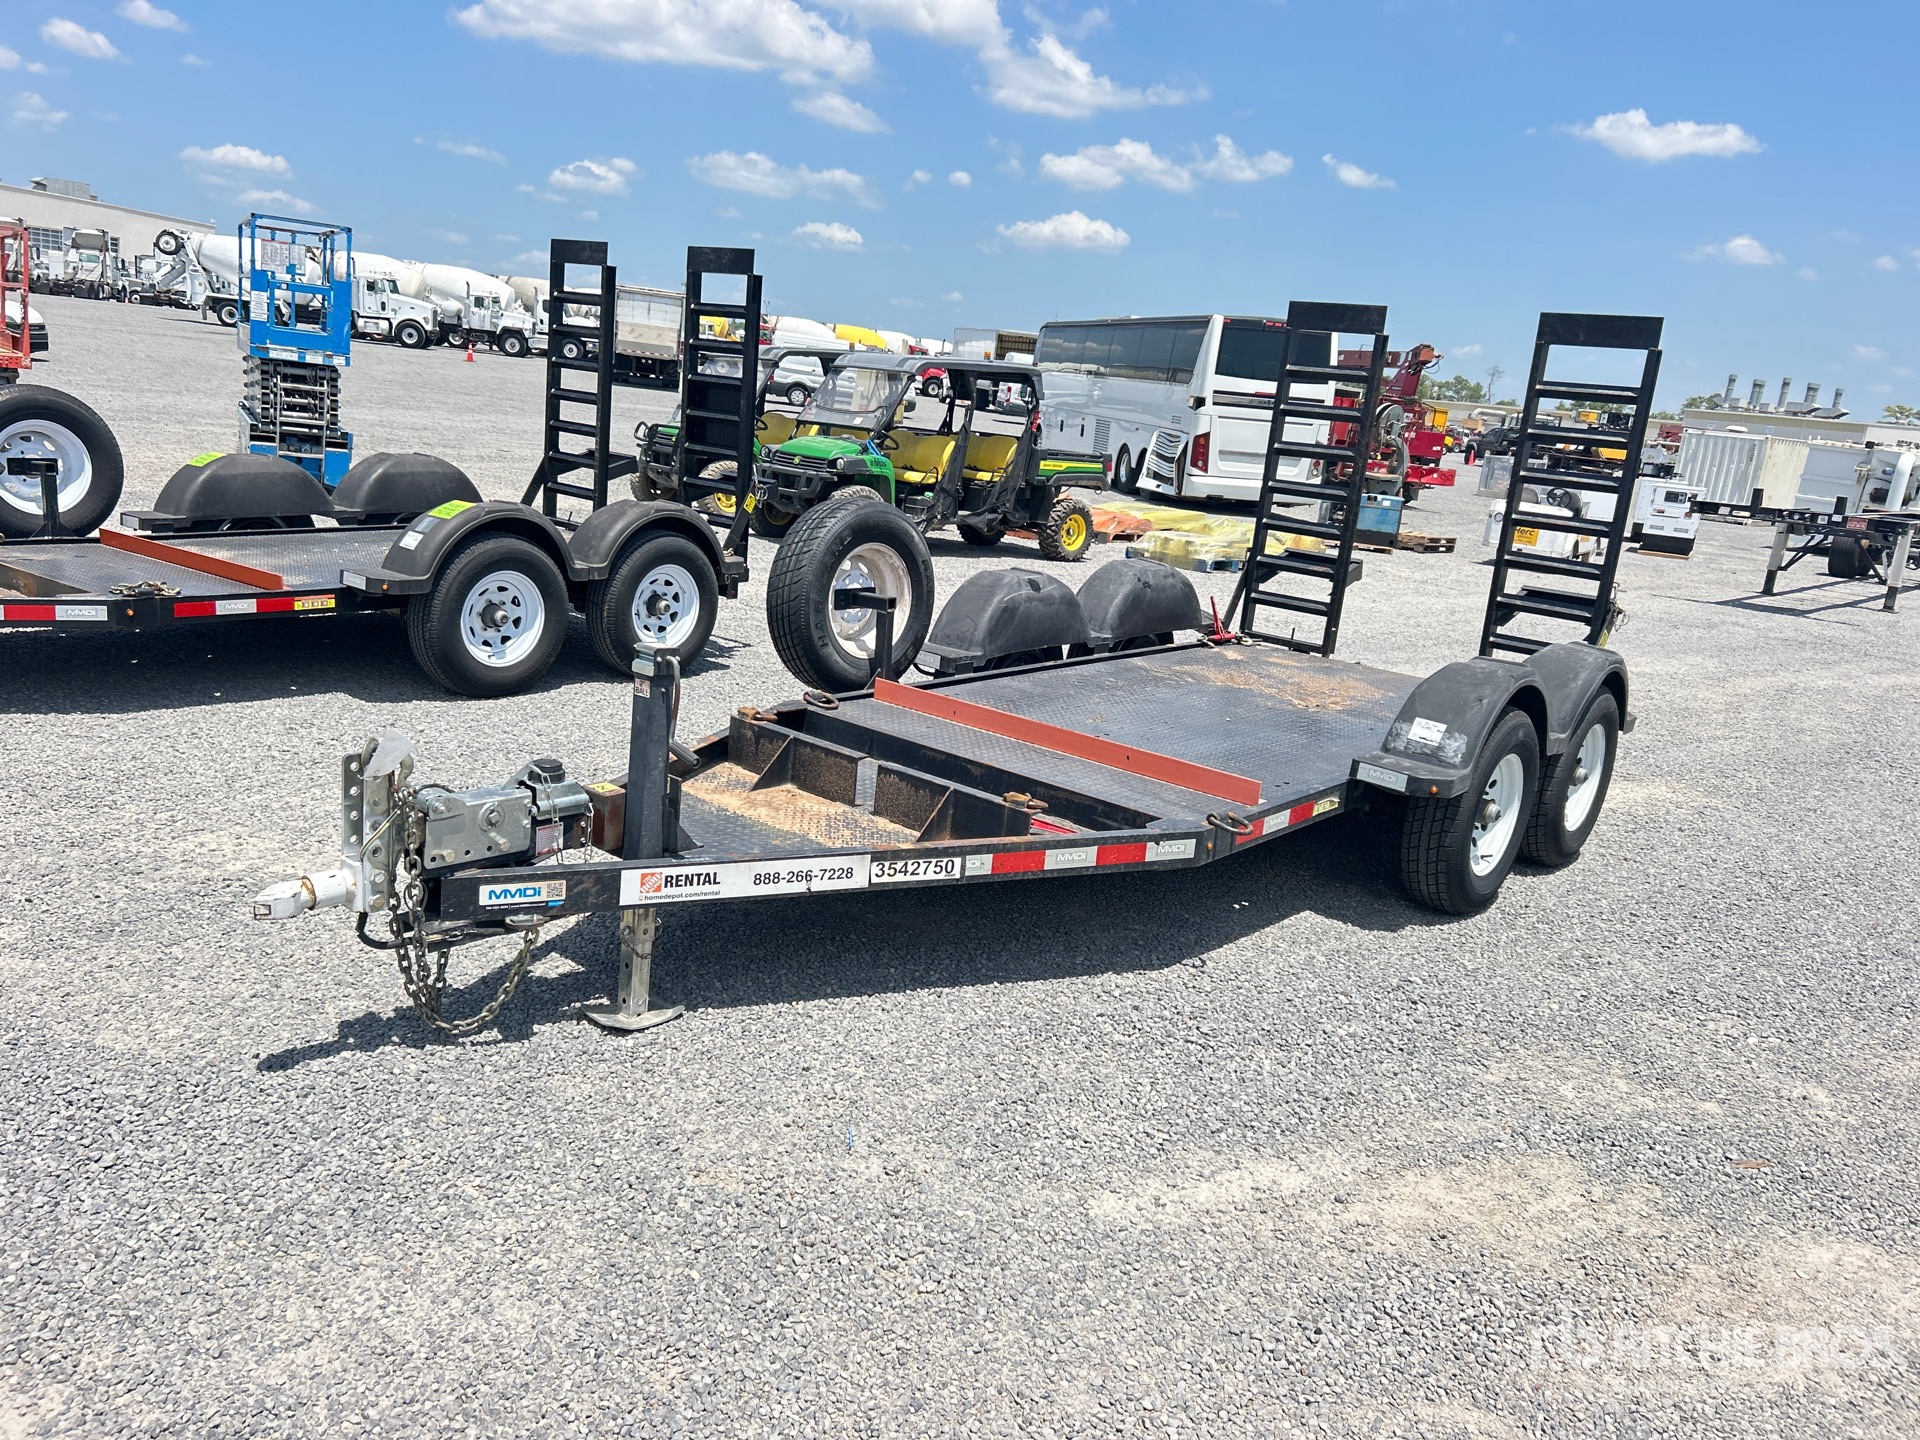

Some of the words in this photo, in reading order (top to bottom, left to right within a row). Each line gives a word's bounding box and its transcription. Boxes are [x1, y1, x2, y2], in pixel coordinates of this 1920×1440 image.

[1369, 769, 1397, 783] MMDI
[1158, 843, 1185, 854] MMDI
[1057, 852, 1085, 862] MMDI
[874, 859, 955, 878] 3542750
[640, 872, 663, 894] HOME
[664, 872, 721, 888] RENTAL
[753, 866, 854, 886] 888-266-7228
[644, 890, 721, 901] homedepot.com/rental
